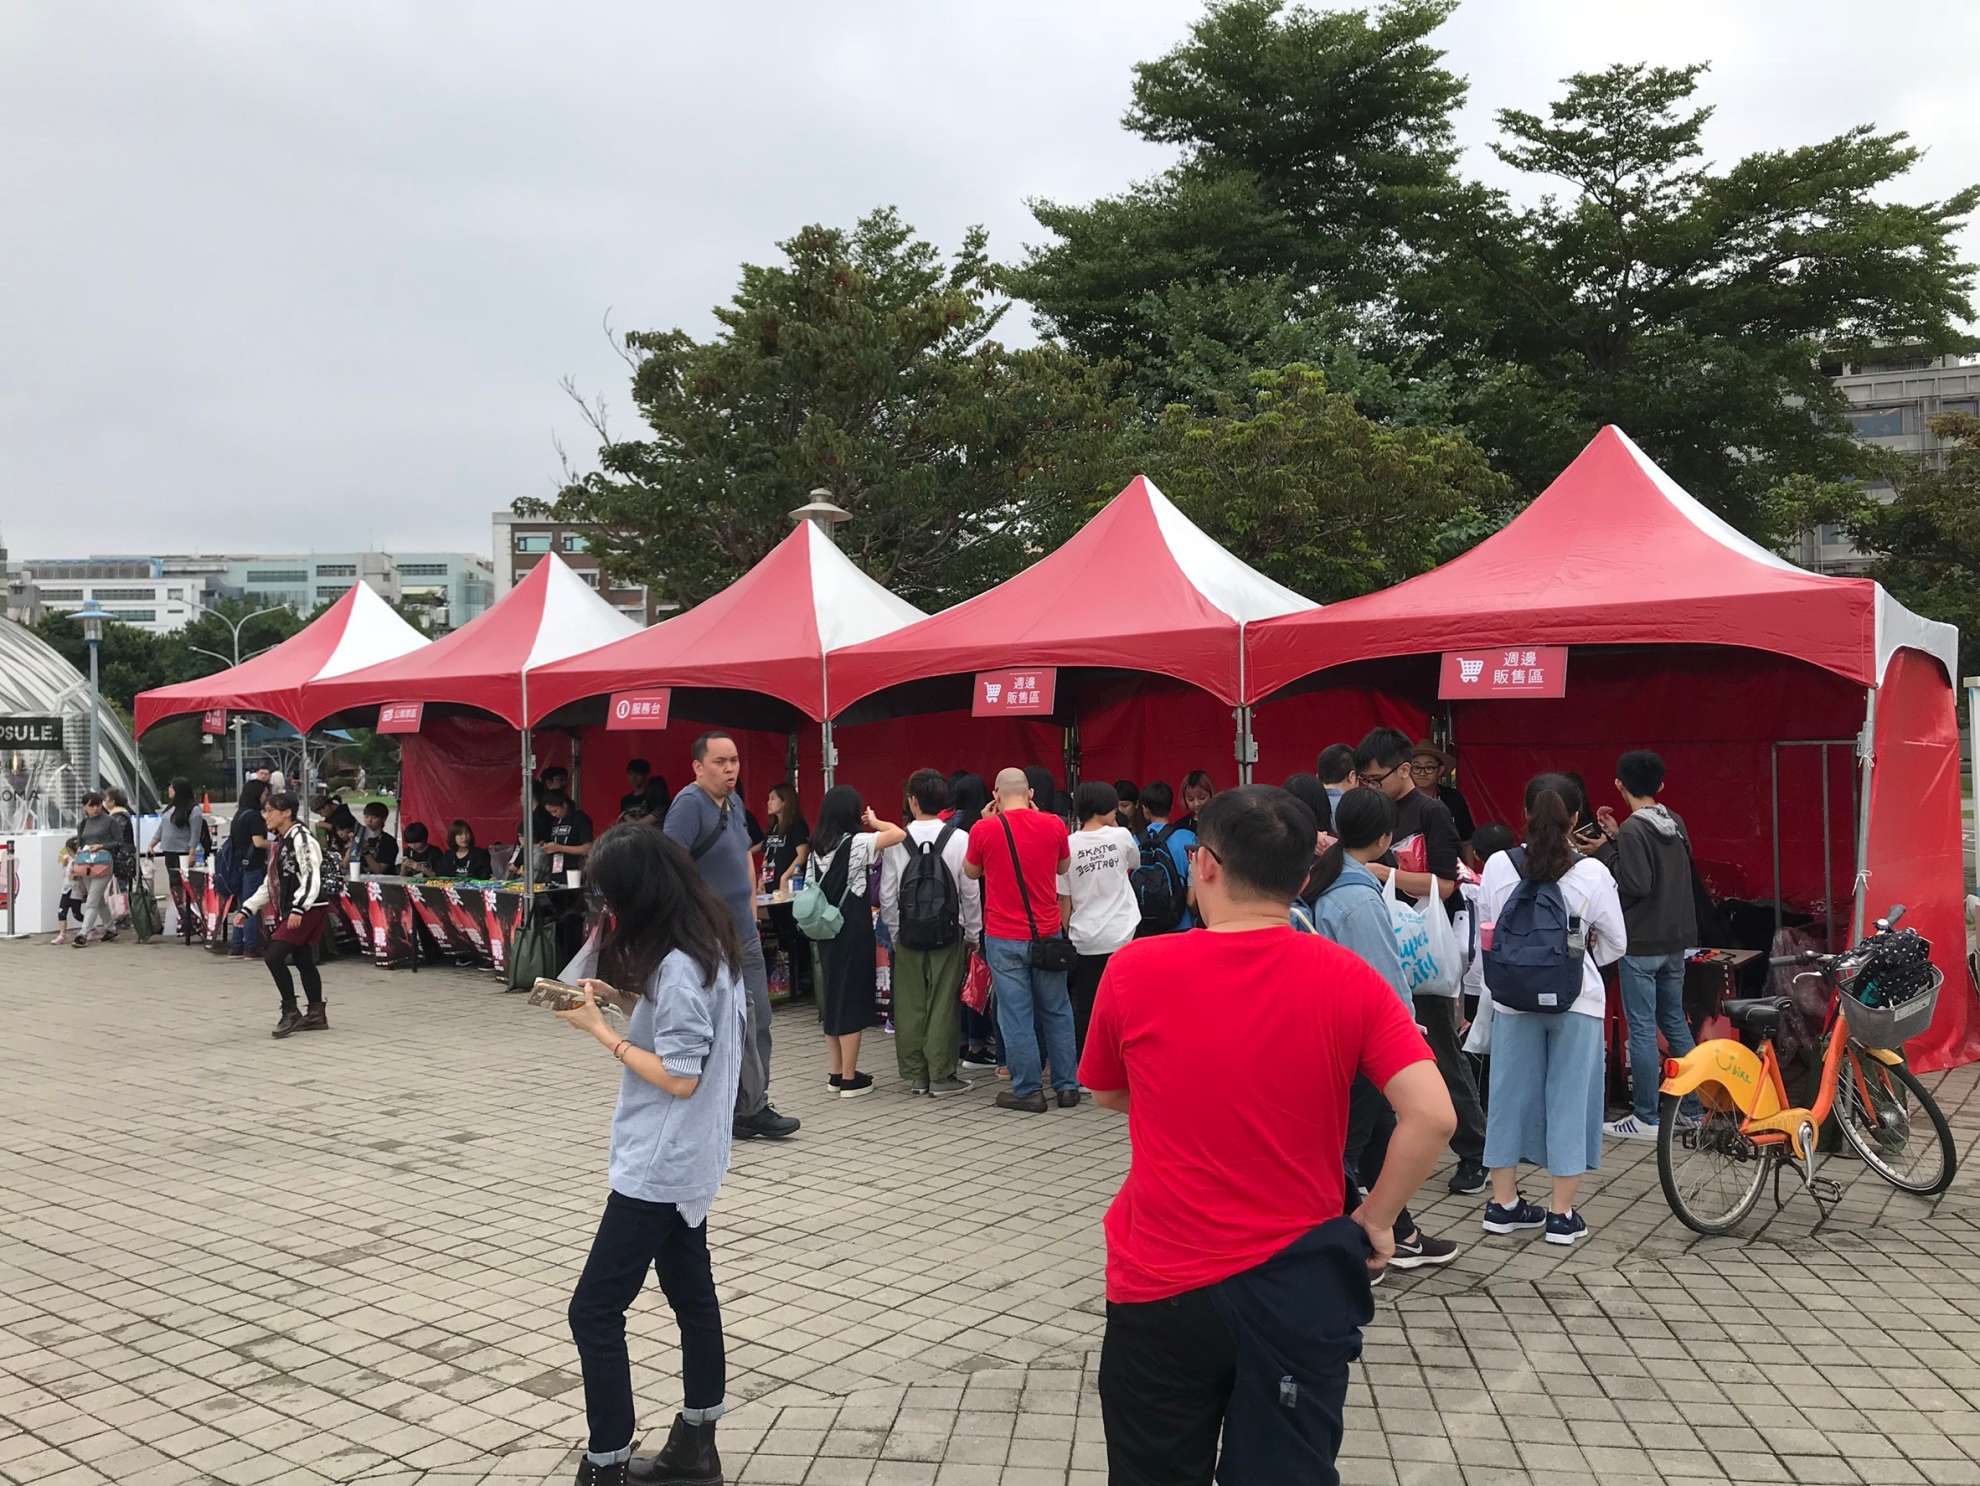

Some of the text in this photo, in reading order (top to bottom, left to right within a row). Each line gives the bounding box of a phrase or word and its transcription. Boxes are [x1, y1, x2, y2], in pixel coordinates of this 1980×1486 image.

[1503, 651, 1537, 667] 週邊
[1493, 668, 1545, 684] 販售區
[1006, 690, 1041, 704] 販售區
[1077, 844, 1118, 859] SKATE
